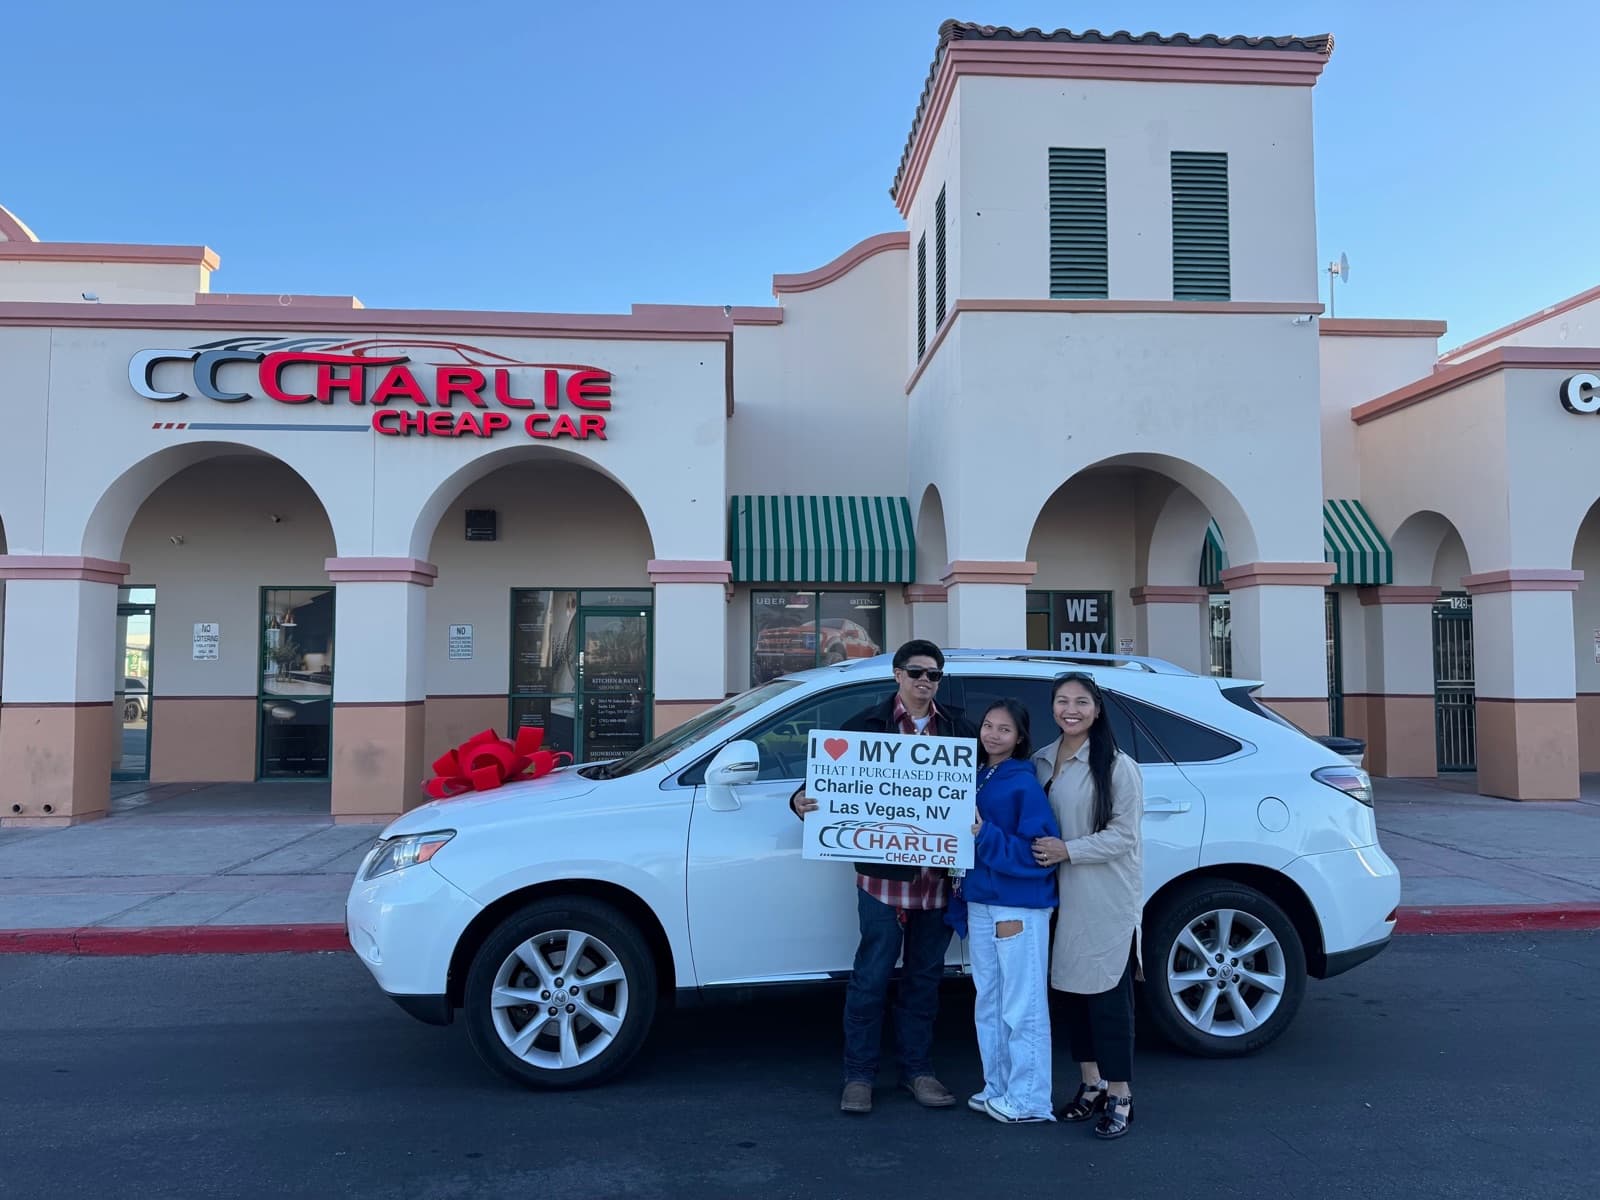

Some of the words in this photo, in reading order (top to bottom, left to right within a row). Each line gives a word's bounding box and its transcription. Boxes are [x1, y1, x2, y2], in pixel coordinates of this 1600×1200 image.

[371, 408, 511, 437] CHEAP
[524, 412, 608, 441] CAR
[756, 597, 786, 606] UBER
[1066, 598, 1099, 622] WE
[201, 624, 211, 633] NO
[456, 626, 466, 635] NO
[1060, 632, 1108, 654] BUY
[811, 737, 817, 759] I
[859, 740, 902, 763] MY
[910, 743, 973, 768] CAR
[812, 764, 847, 777] THAT
[851, 767, 855, 777] I
[859, 767, 934, 781] PURCHASED
[937, 771, 973, 783] FROM
[814, 778, 874, 795] Charlie
[878, 782, 933, 802] Cheap
[937, 785, 968, 800] Car
[829, 800, 860, 815] Las
[865, 802, 921, 821] Vegas,
[926, 805, 951, 820] NV
[885, 852, 927, 864] CHEAP
[930, 855, 957, 866] CAR
